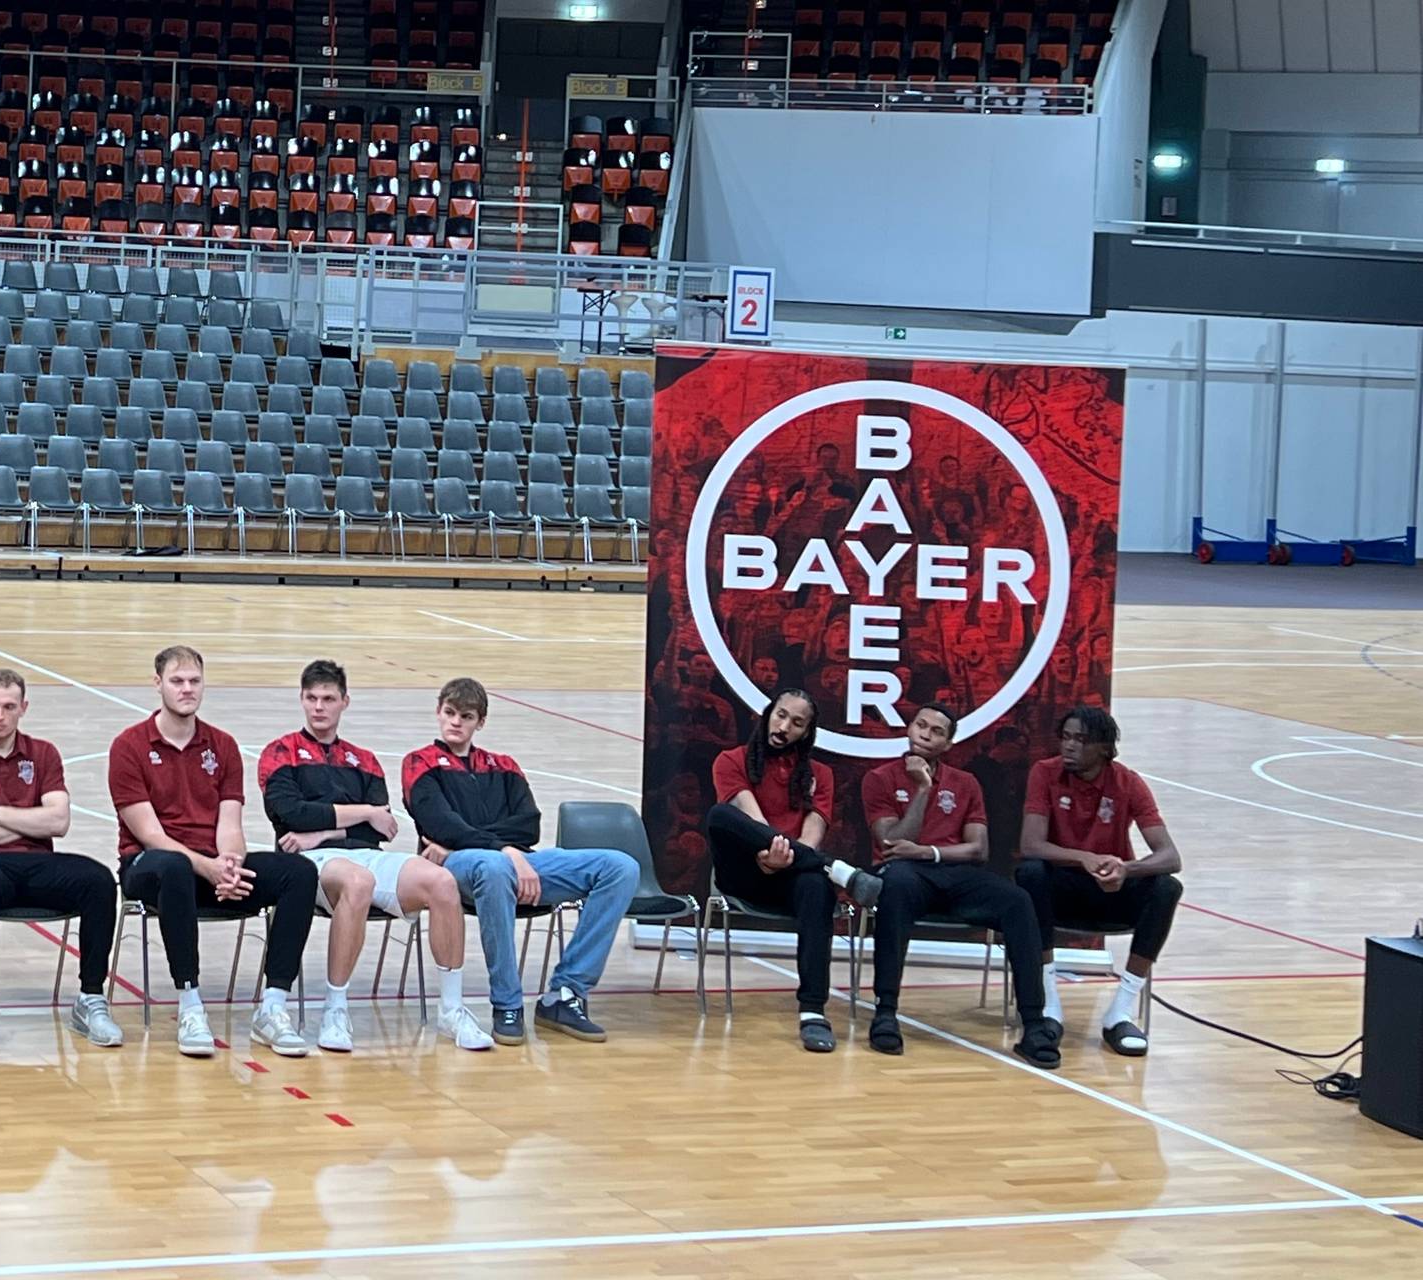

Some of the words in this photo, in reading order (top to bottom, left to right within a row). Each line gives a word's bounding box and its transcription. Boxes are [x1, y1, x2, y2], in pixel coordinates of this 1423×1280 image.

[429, 75, 464, 89] Block
[572, 81, 608, 94] Block
[615, 81, 626, 94] B
[738, 286, 765, 295] BLOCK
[741, 299, 758, 326] 2
[722, 533, 1037, 605] BAYER
[844, 414, 913, 728] BAYER
